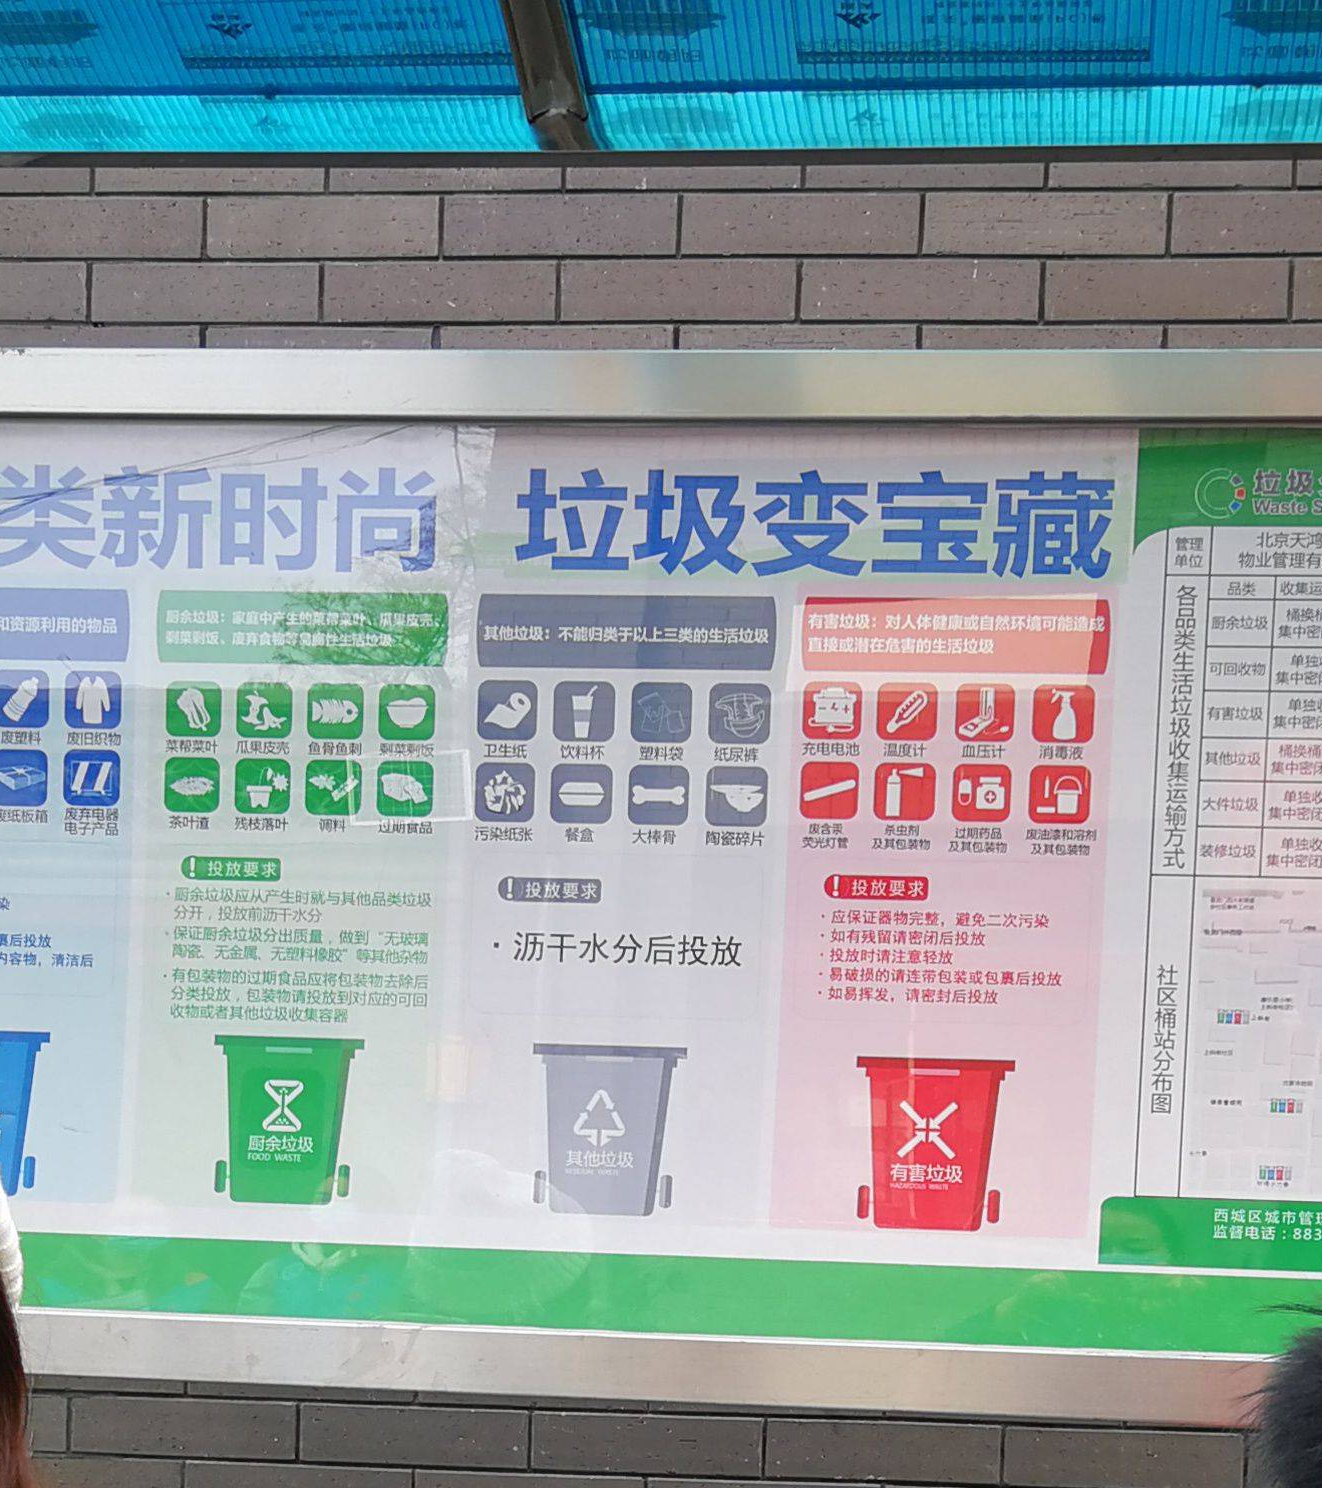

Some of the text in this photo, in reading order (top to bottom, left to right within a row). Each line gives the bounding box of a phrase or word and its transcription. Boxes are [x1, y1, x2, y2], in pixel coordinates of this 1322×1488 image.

[1253, 498, 1308, 516] Waste
[515, 468, 1115, 579] 垃圾变宝藏
[1175, 536, 1204, 552] 管理
[1174, 553, 1204, 569] 单位
[1227, 582, 1256, 597] 品类
[1211, 616, 1268, 633] 厨余垃圾
[807, 635, 994, 655] 直接或潜在危害的生活垃圾
[1209, 662, 1266, 677] 可回收物
[1207, 706, 1263, 722] 有害垃圾
[1163, 585, 1198, 869] 各品类生活垃圾收集运输方式
[1, 729, 41, 746] 废塑料
[66, 731, 122, 747] 废旧织物
[235, 740, 290, 756] 瓜果皮壳
[308, 741, 362, 757] 鱼骨鱼刺
[483, 743, 528, 759] 卫生纸
[560, 743, 605, 759] 饮料杯
[638, 745, 684, 761] 塑料袋
[713, 746, 759, 763] 纸尿裤
[802, 741, 860, 757] 充电电池
[883, 742, 926, 759] 温度计
[962, 743, 1005, 759] 血压计
[1039, 744, 1084, 760] 消毒液
[1205, 752, 1261, 767] 其他垃圾
[1202, 797, 1258, 812] 大件垃圾
[475, 826, 533, 843] 污染纸张
[565, 827, 594, 843] 餐盒
[632, 828, 676, 846] 大棒骨
[705, 830, 764, 847] 陶瓷碎片
[1200, 843, 1256, 858] 装修垃圾
[208, 860, 277, 878] 投放要求
[525, 882, 598, 900] 投放要求
[851, 879, 924, 898] 投放要求
[830, 928, 986, 947] 如有残留请密闭后投放
[512, 931, 743, 968] 沥干水分后投放
[829, 949, 953, 966] 投放时请注意轻放
[1150, 963, 1180, 1115] 社区桶站分布图
[247, 1135, 314, 1154] 厨余垃圾
[247, 1152, 302, 1163] FOOD WASTE
[566, 1150, 634, 1168] 其他垃圾
[890, 1163, 963, 1183] 有害垃圾
